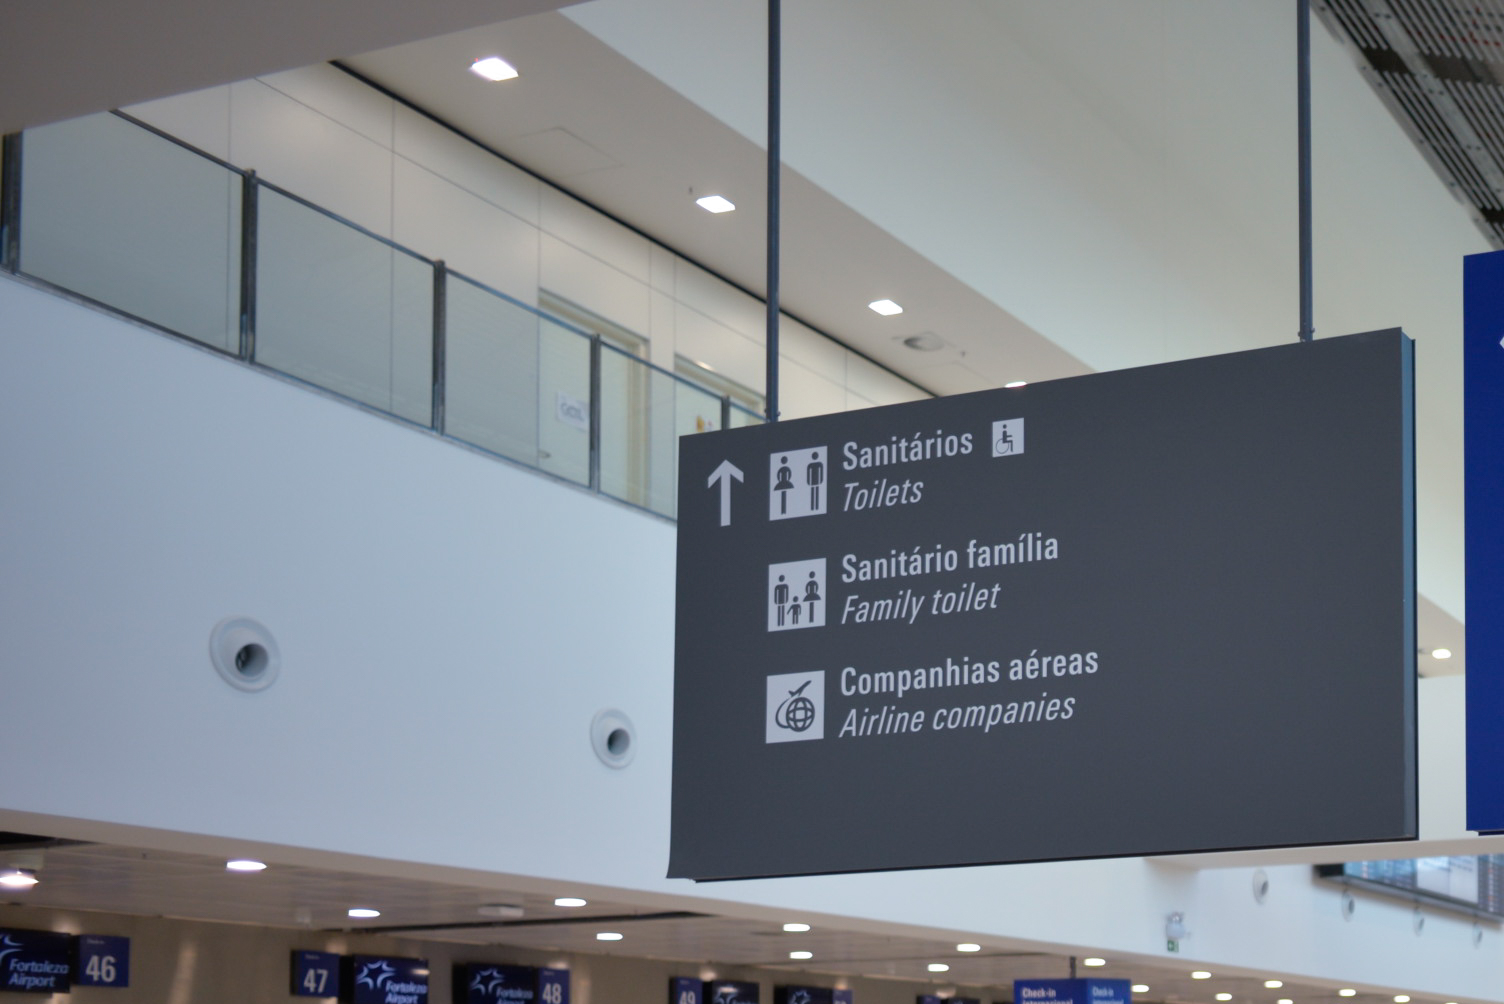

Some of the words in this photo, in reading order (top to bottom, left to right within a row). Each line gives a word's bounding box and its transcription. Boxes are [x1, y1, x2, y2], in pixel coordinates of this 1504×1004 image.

[843, 432, 973, 471] Sanitários
[843, 478, 924, 512] Toilets
[841, 546, 958, 583] Sanitário
[966, 532, 1060, 569] família
[841, 589, 925, 625] Family
[931, 581, 1001, 615] toilet
[840, 656, 1000, 698] Companhias
[1009, 649, 1099, 681] aéreas
[838, 704, 925, 738] Airline
[932, 695, 1076, 734] companies
[9, 957, 70, 975] Fortaleza
[85, 954, 117, 983] 46
[8, 972, 56, 990] Airport
[303, 968, 329, 994] 47
[385, 979, 428, 995] Fortaleza
[1021, 986, 1057, 999] Check-in
[1091, 985, 1114, 998] Check-in
